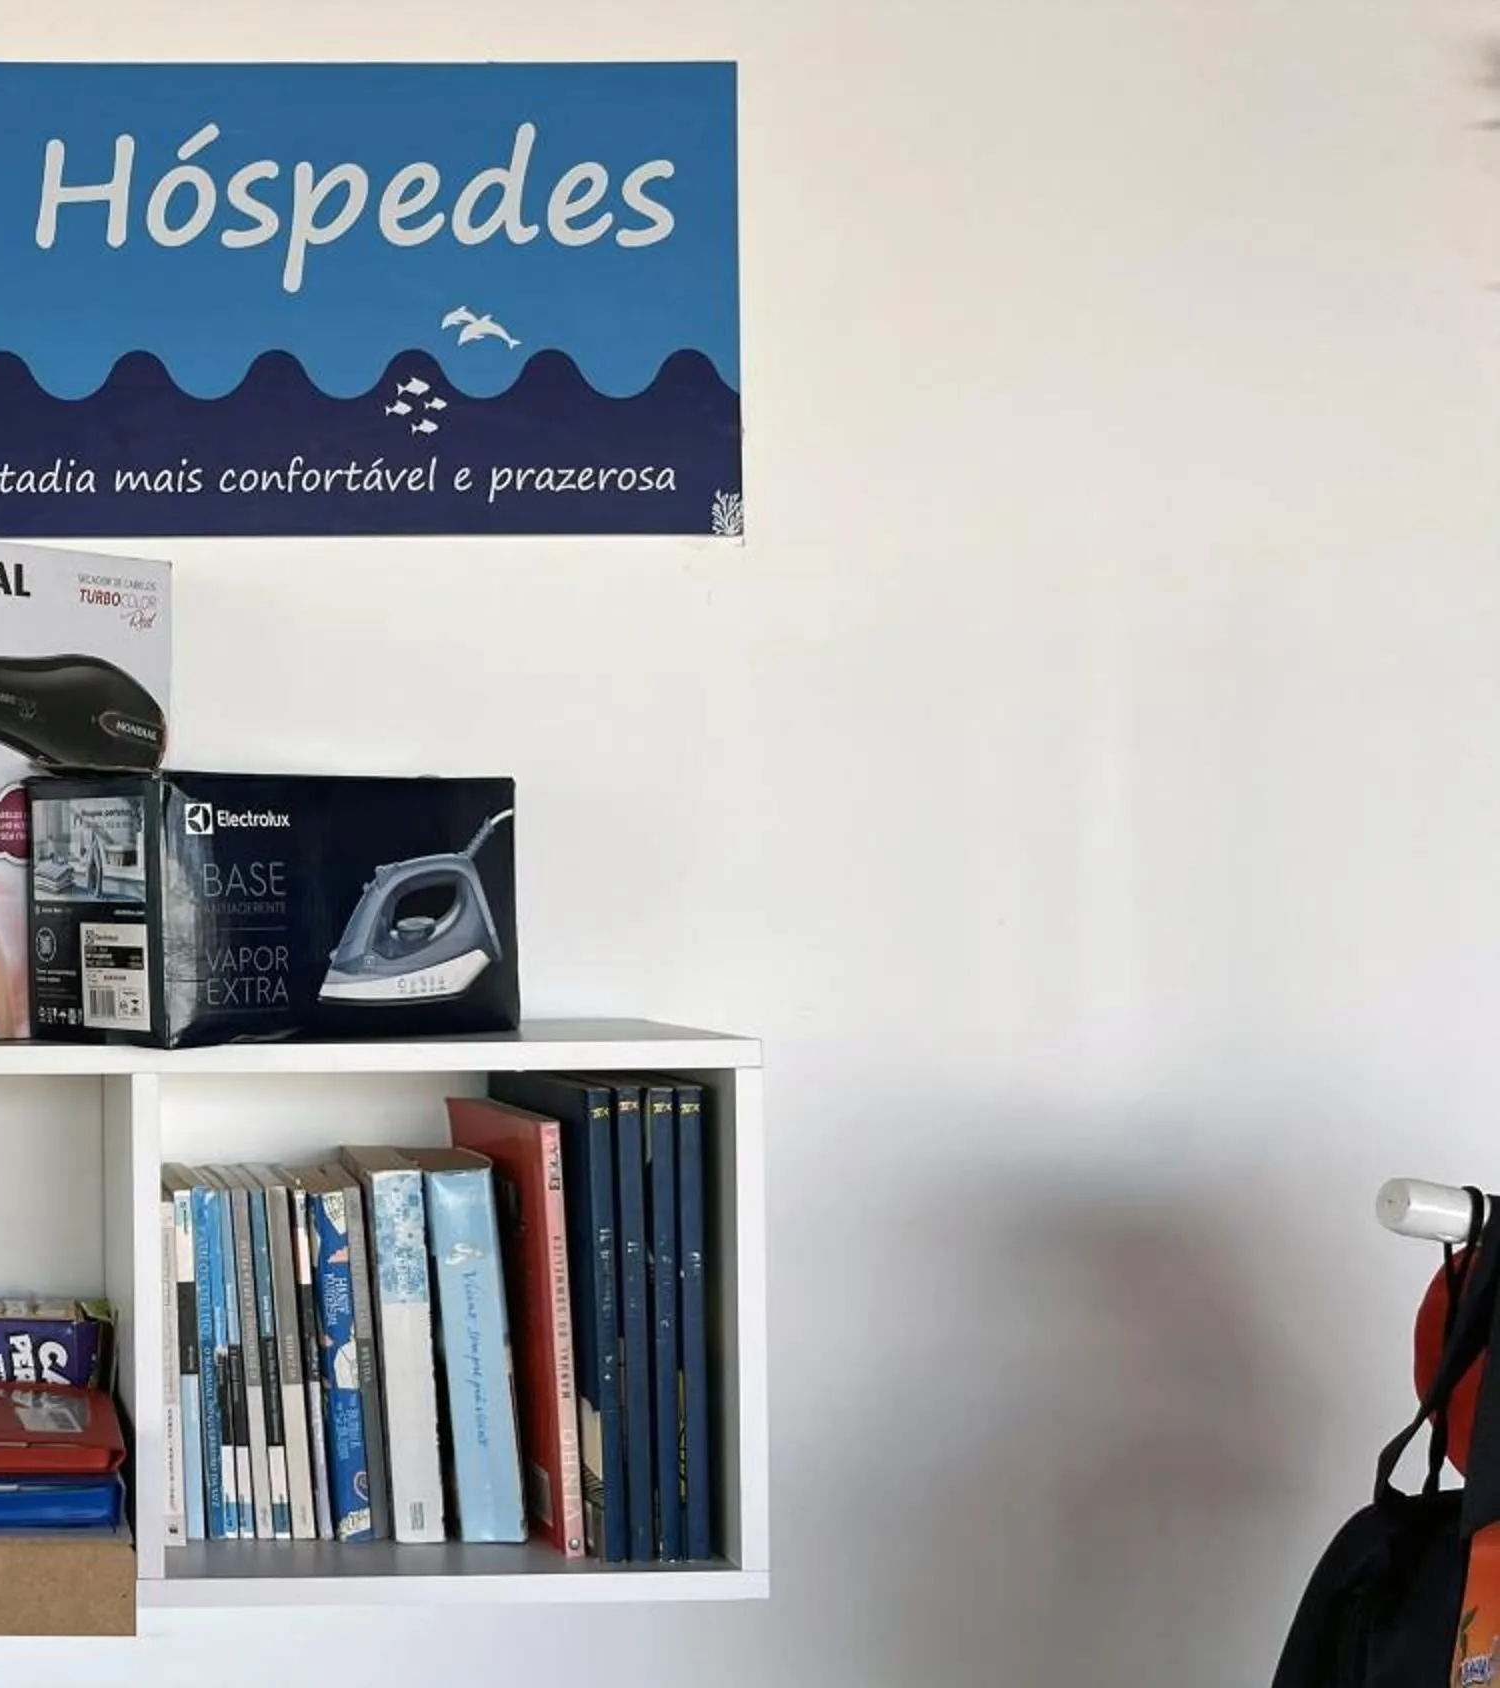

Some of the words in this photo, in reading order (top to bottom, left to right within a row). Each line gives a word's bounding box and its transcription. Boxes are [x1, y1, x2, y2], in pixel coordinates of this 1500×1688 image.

[35, 122, 677, 295] Hóspedes
[116, 459, 204, 494] mais
[220, 456, 438, 494] confortável
[454, 468, 474, 493] e
[489, 467, 677, 505] prazerosa
[115, 719, 157, 741] MONDIAL
[217, 809, 291, 829] Electrolux
[203, 861, 287, 897] BASE
[206, 947, 289, 973] VAPOR
[206, 978, 289, 1005] EXTRA
